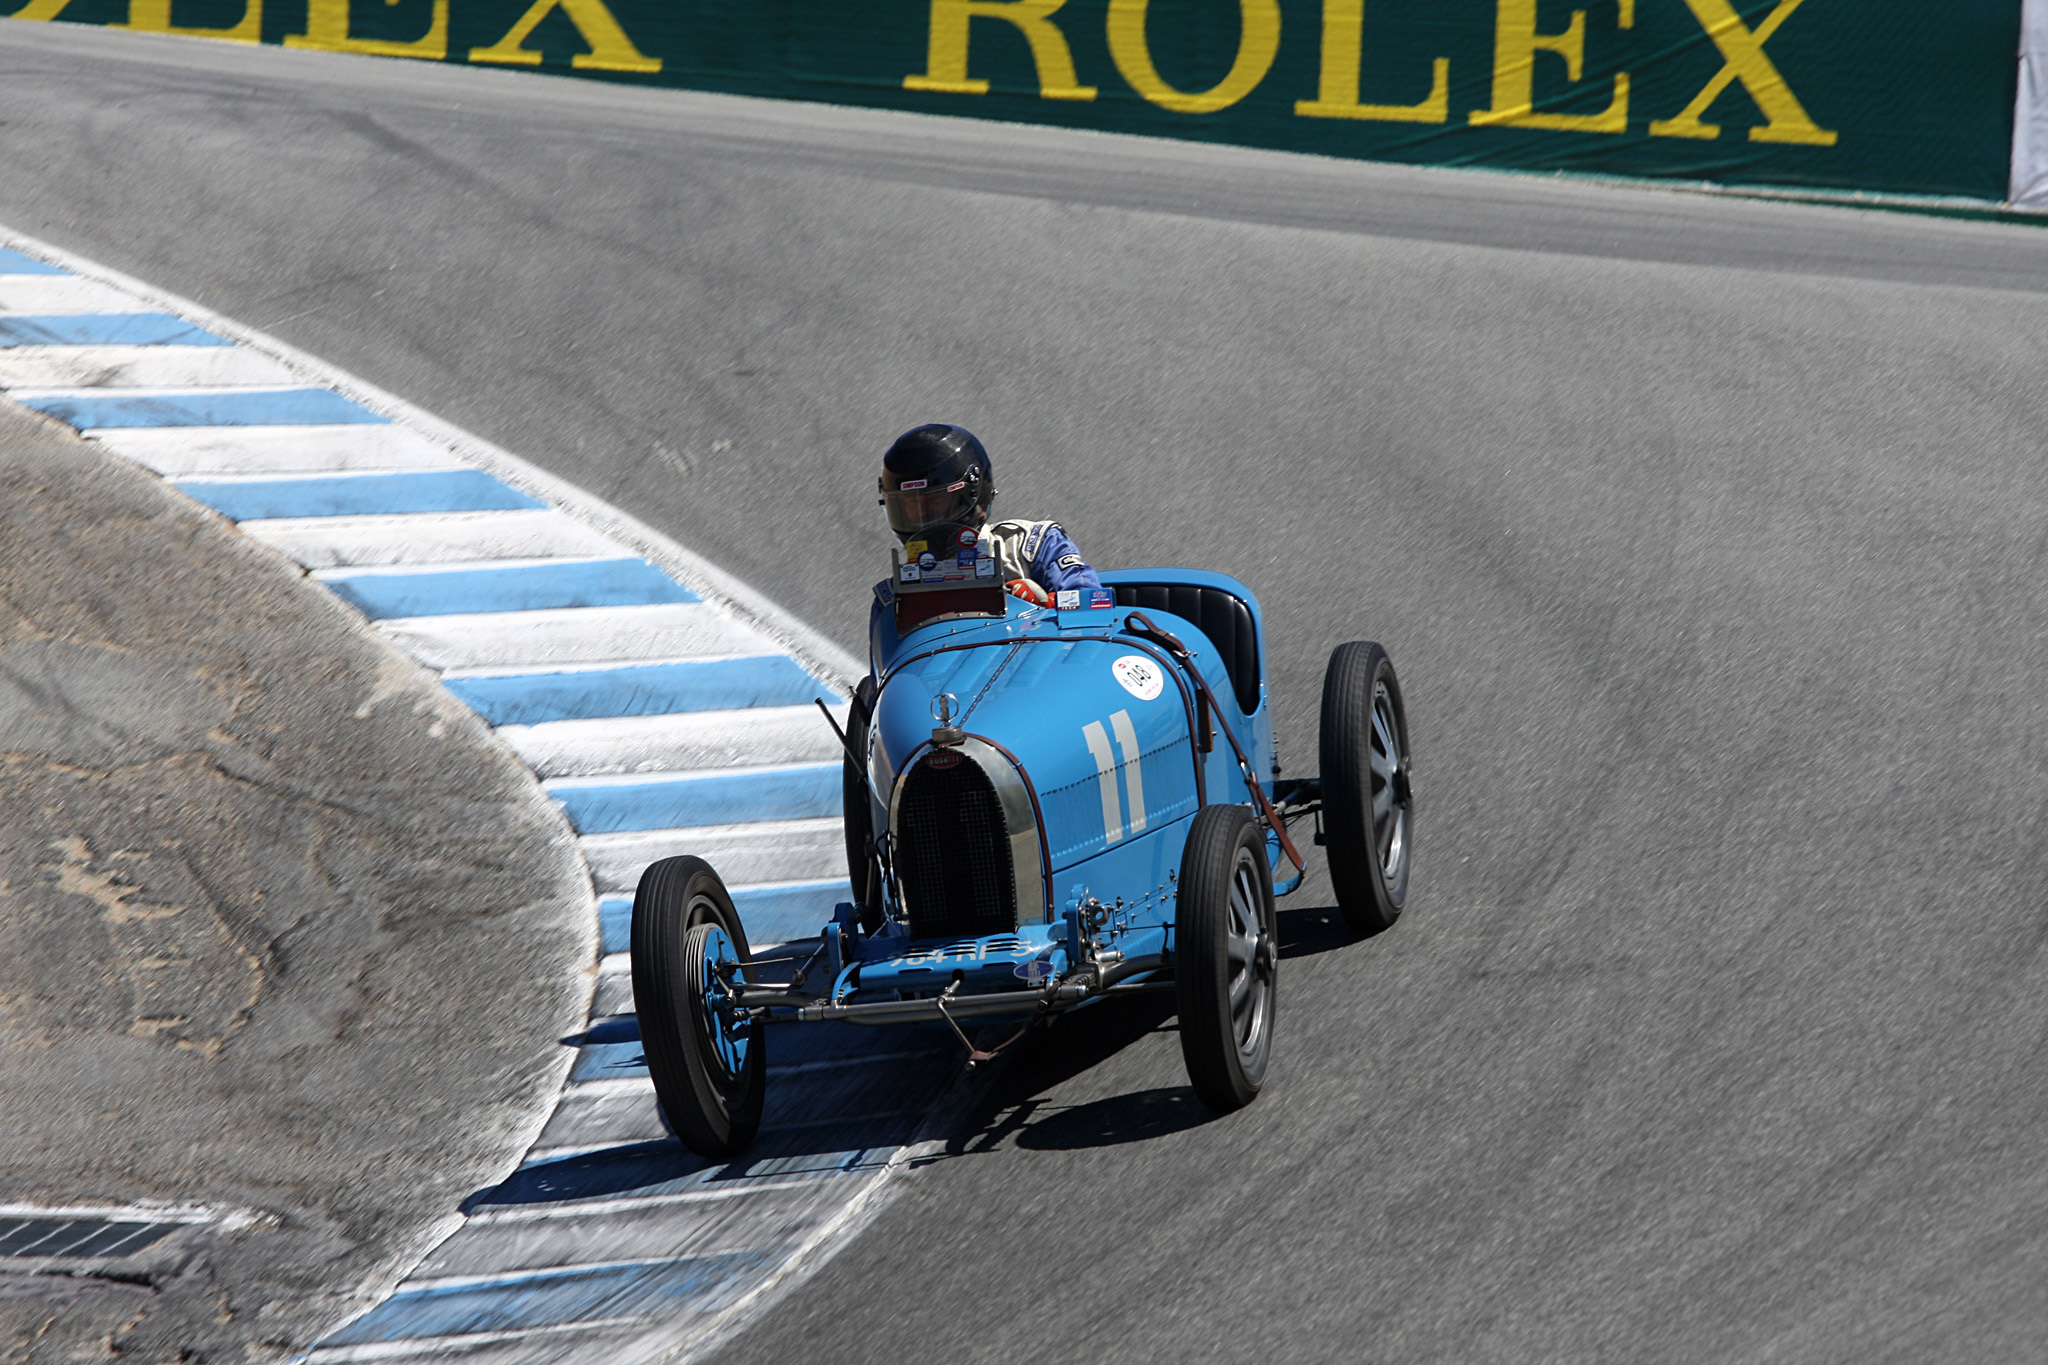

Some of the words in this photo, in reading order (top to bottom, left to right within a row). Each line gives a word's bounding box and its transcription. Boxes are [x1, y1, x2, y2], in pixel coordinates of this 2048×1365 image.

[902, 0, 1838, 146] ROLEX
[1126, 664, 1152, 687] 048
[1081, 708, 1147, 845] 11
